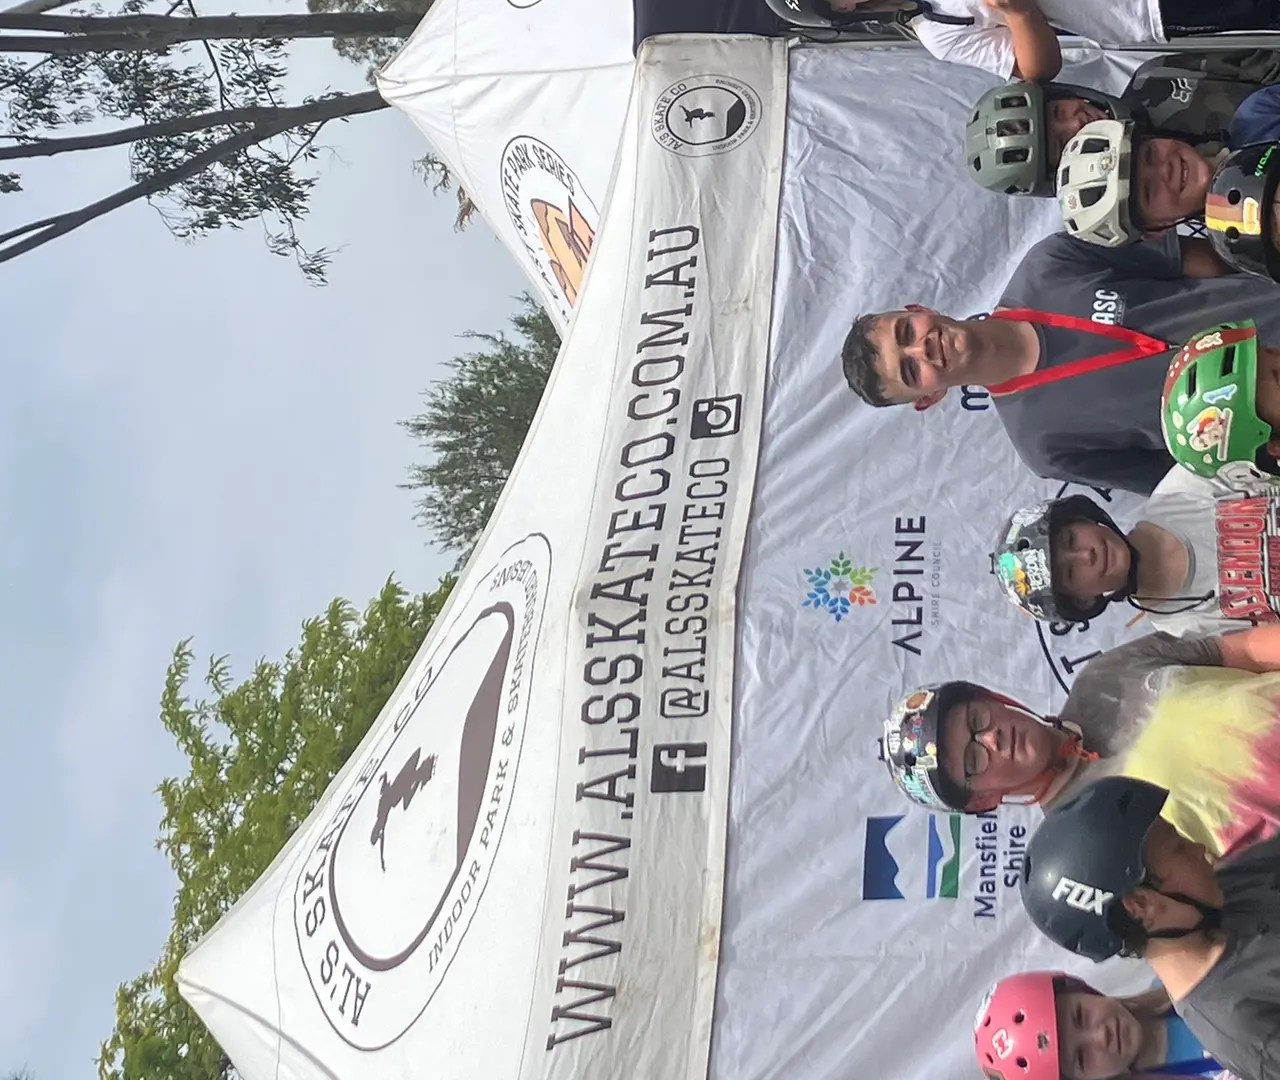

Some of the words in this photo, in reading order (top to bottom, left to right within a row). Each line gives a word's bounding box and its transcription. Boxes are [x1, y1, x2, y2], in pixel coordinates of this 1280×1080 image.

[654, 96, 672, 132] SKATE
[670, 82, 688, 96] CO
[659, 132, 683, 151] AL'S
[1091, 289, 1119, 325] ASC
[658, 456, 731, 719] @ALSSKATECO
[890, 515, 926, 656] ALPINE
[931, 540, 942, 588] COUNCIL
[931, 592, 940, 627] SHIRE
[546, 225, 699, 1051] WWW.ALSSKATECO.COM.AU
[302, 757, 380, 937] SKATE
[427, 860, 481, 974] INDOOR
[477, 757, 510, 850] PARK
[500, 720, 514, 746] &
[973, 813, 998, 918] Mansfiel
[1003, 824, 1026, 888] Shire
[1051, 876, 1115, 916] FOX
